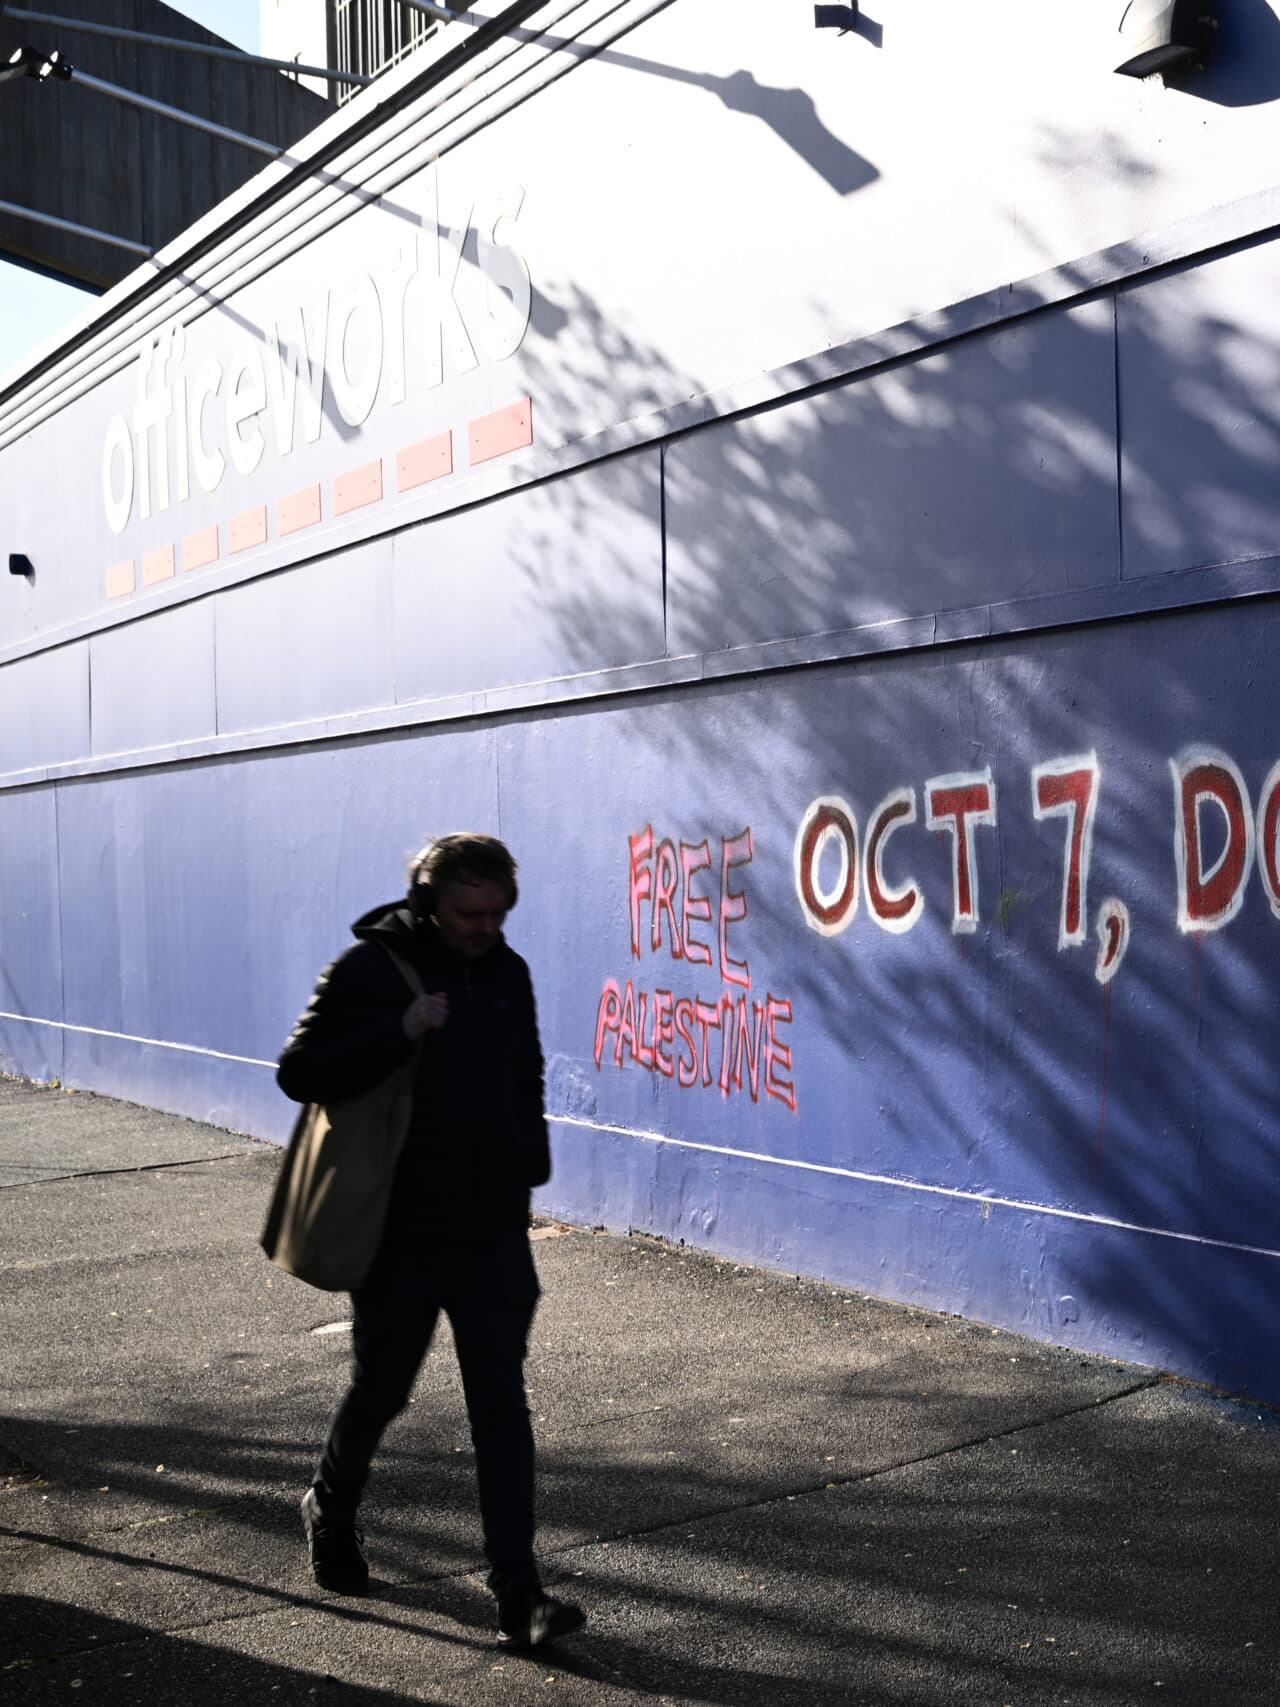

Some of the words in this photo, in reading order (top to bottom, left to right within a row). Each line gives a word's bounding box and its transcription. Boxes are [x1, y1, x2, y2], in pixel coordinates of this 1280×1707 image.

[103, 164, 532, 535] officeworks
[628, 823, 752, 989] FREE
[794, 766, 996, 936] OCT
[1032, 749, 1130, 984] 7,
[593, 977, 797, 1112] PALESTINE
